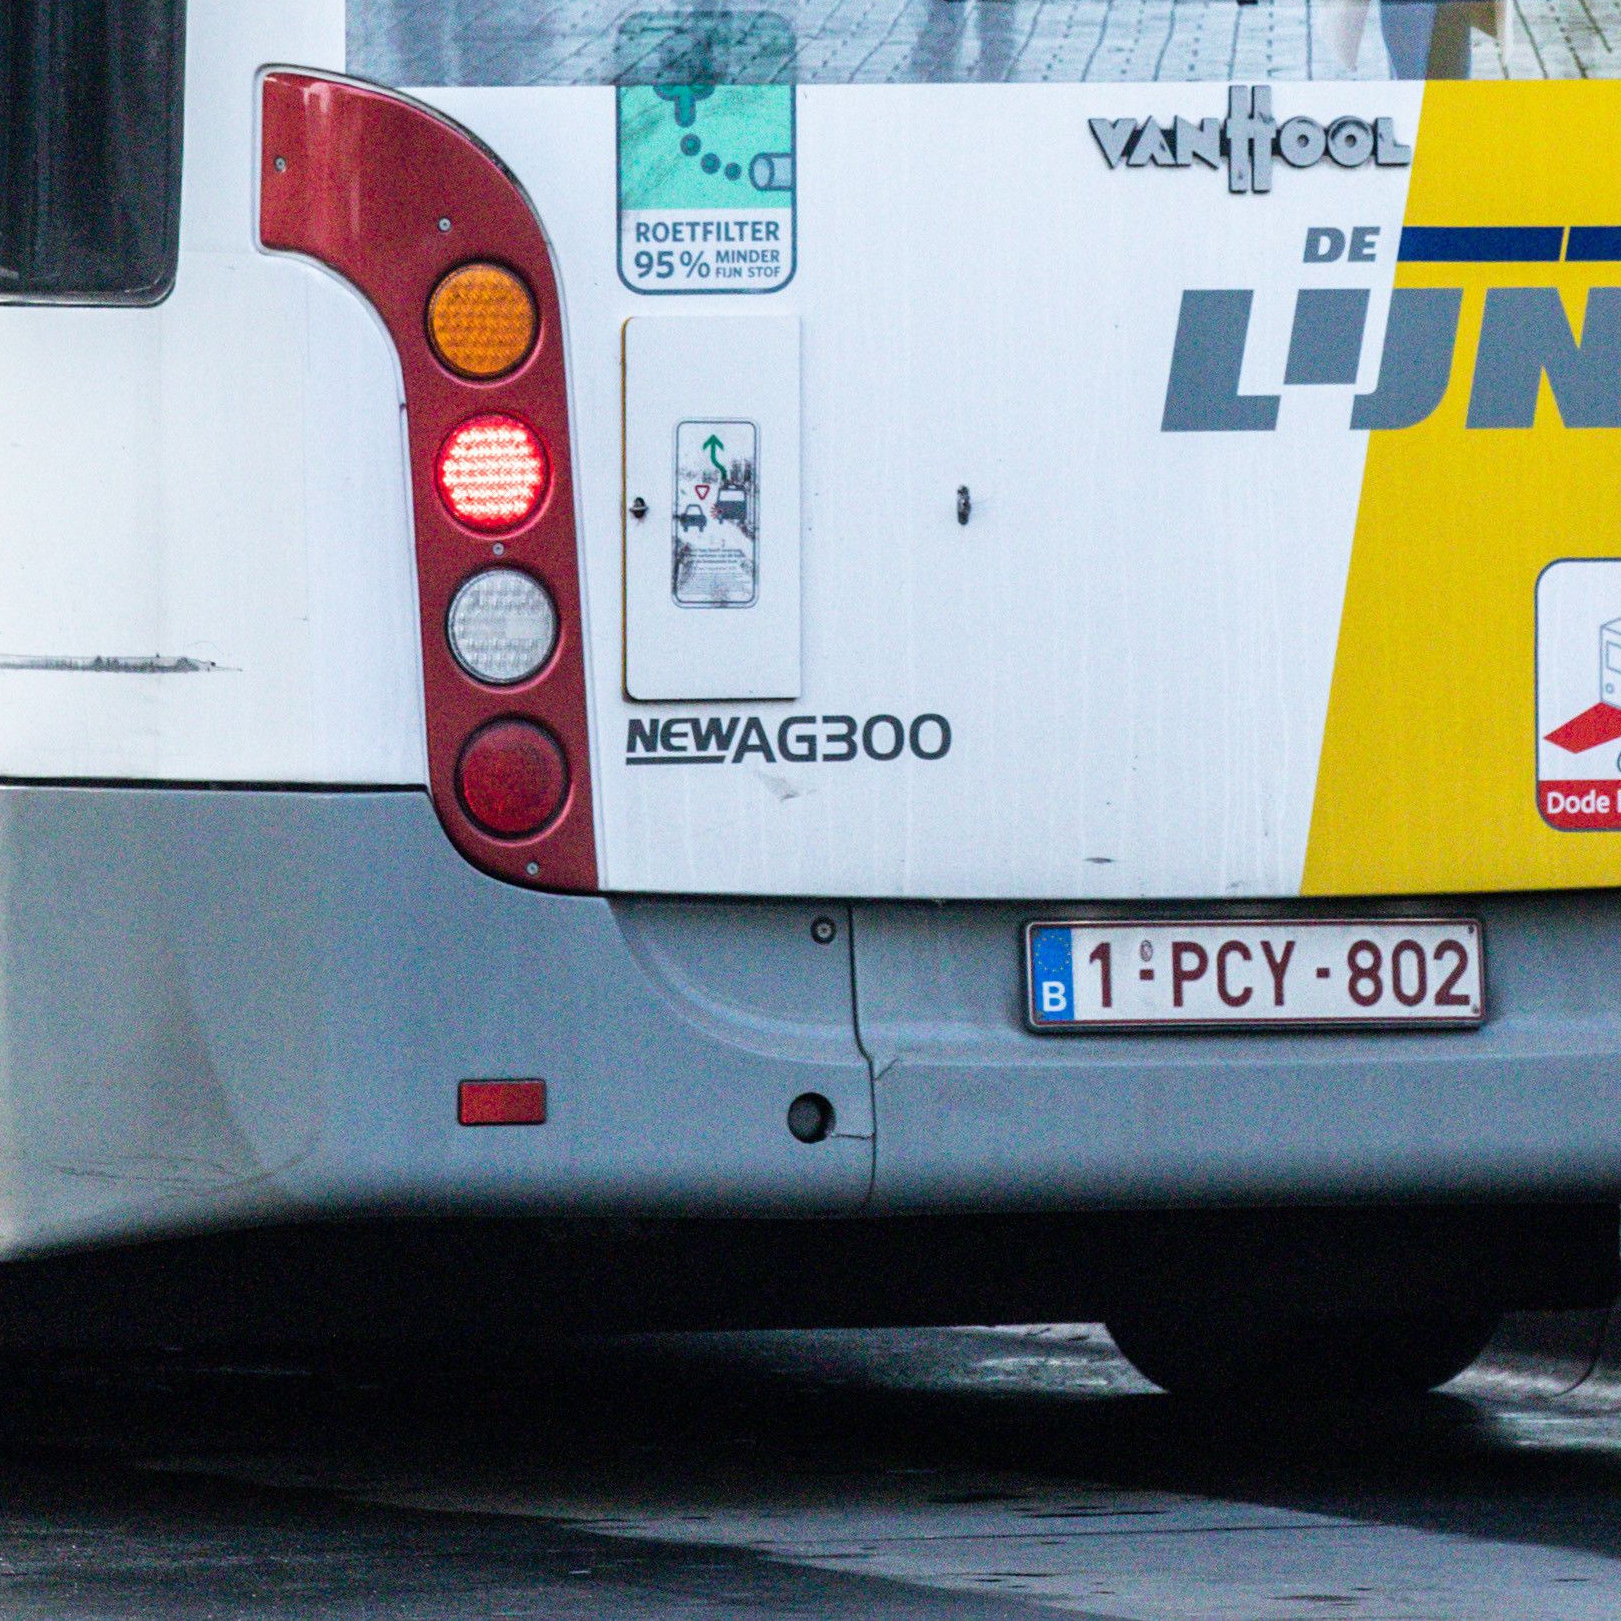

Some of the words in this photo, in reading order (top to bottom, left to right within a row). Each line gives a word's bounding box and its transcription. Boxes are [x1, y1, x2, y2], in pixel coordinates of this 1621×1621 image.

[635, 220, 781, 244] ROETFILTER
[715, 249, 781, 264] MINDER
[1303, 226, 1381, 264] DE
[715, 266, 743, 278] FIJN
[747, 265, 781, 278] STOF
[1546, 789, 1610, 814] Dode
[1040, 980, 1068, 1012] B
